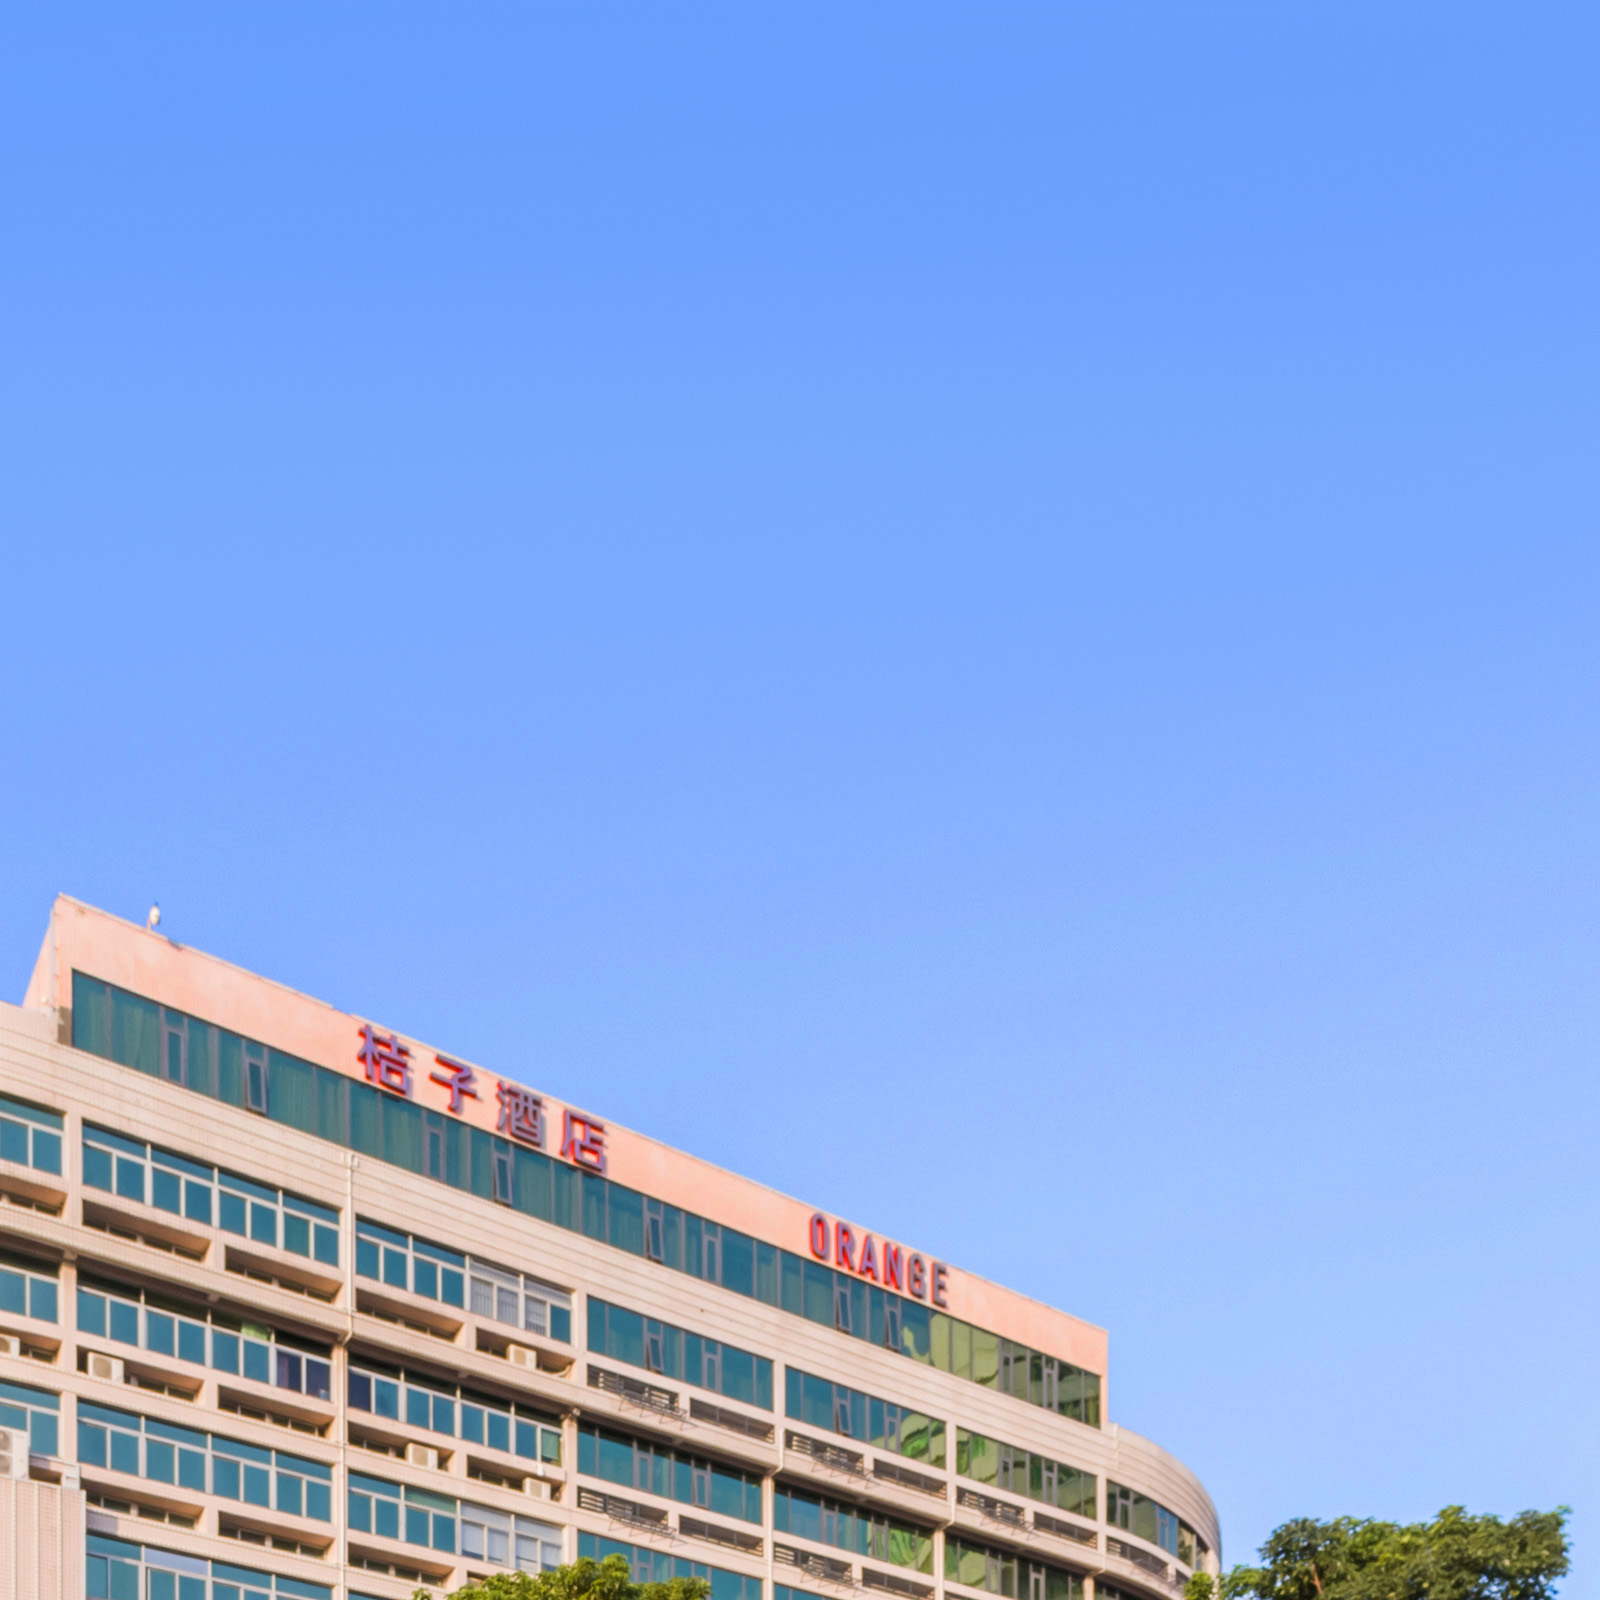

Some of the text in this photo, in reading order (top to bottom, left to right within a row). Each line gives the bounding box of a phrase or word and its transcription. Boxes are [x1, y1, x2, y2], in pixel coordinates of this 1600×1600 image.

[357, 1024, 608, 1172] 桔子酒店
[809, 1212, 949, 1308] ORANGE
